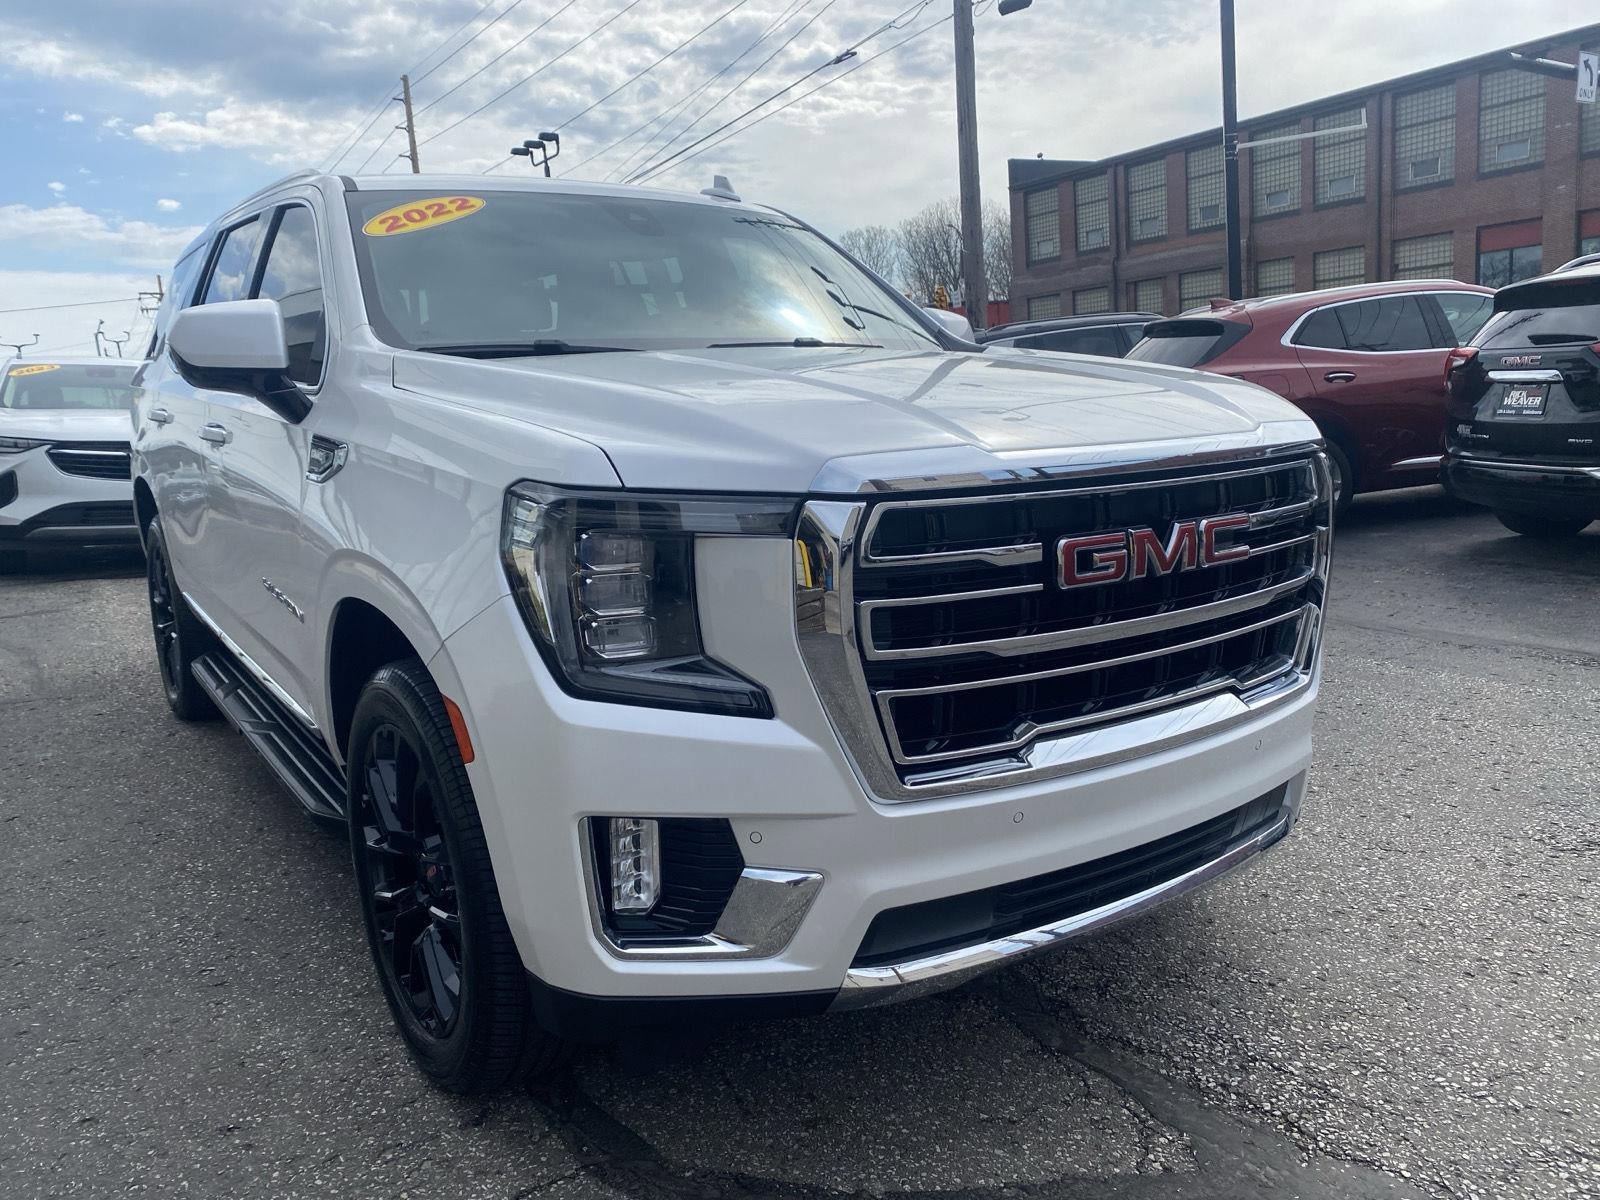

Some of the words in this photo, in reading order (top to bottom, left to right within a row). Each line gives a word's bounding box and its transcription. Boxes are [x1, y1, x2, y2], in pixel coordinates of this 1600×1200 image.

[1579, 87, 1594, 99] ONLY
[378, 198, 477, 234] 2022
[1501, 355, 1542, 366] GMC
[1503, 396, 1542, 405] WEAVER
[1057, 511, 1250, 590] GMC
